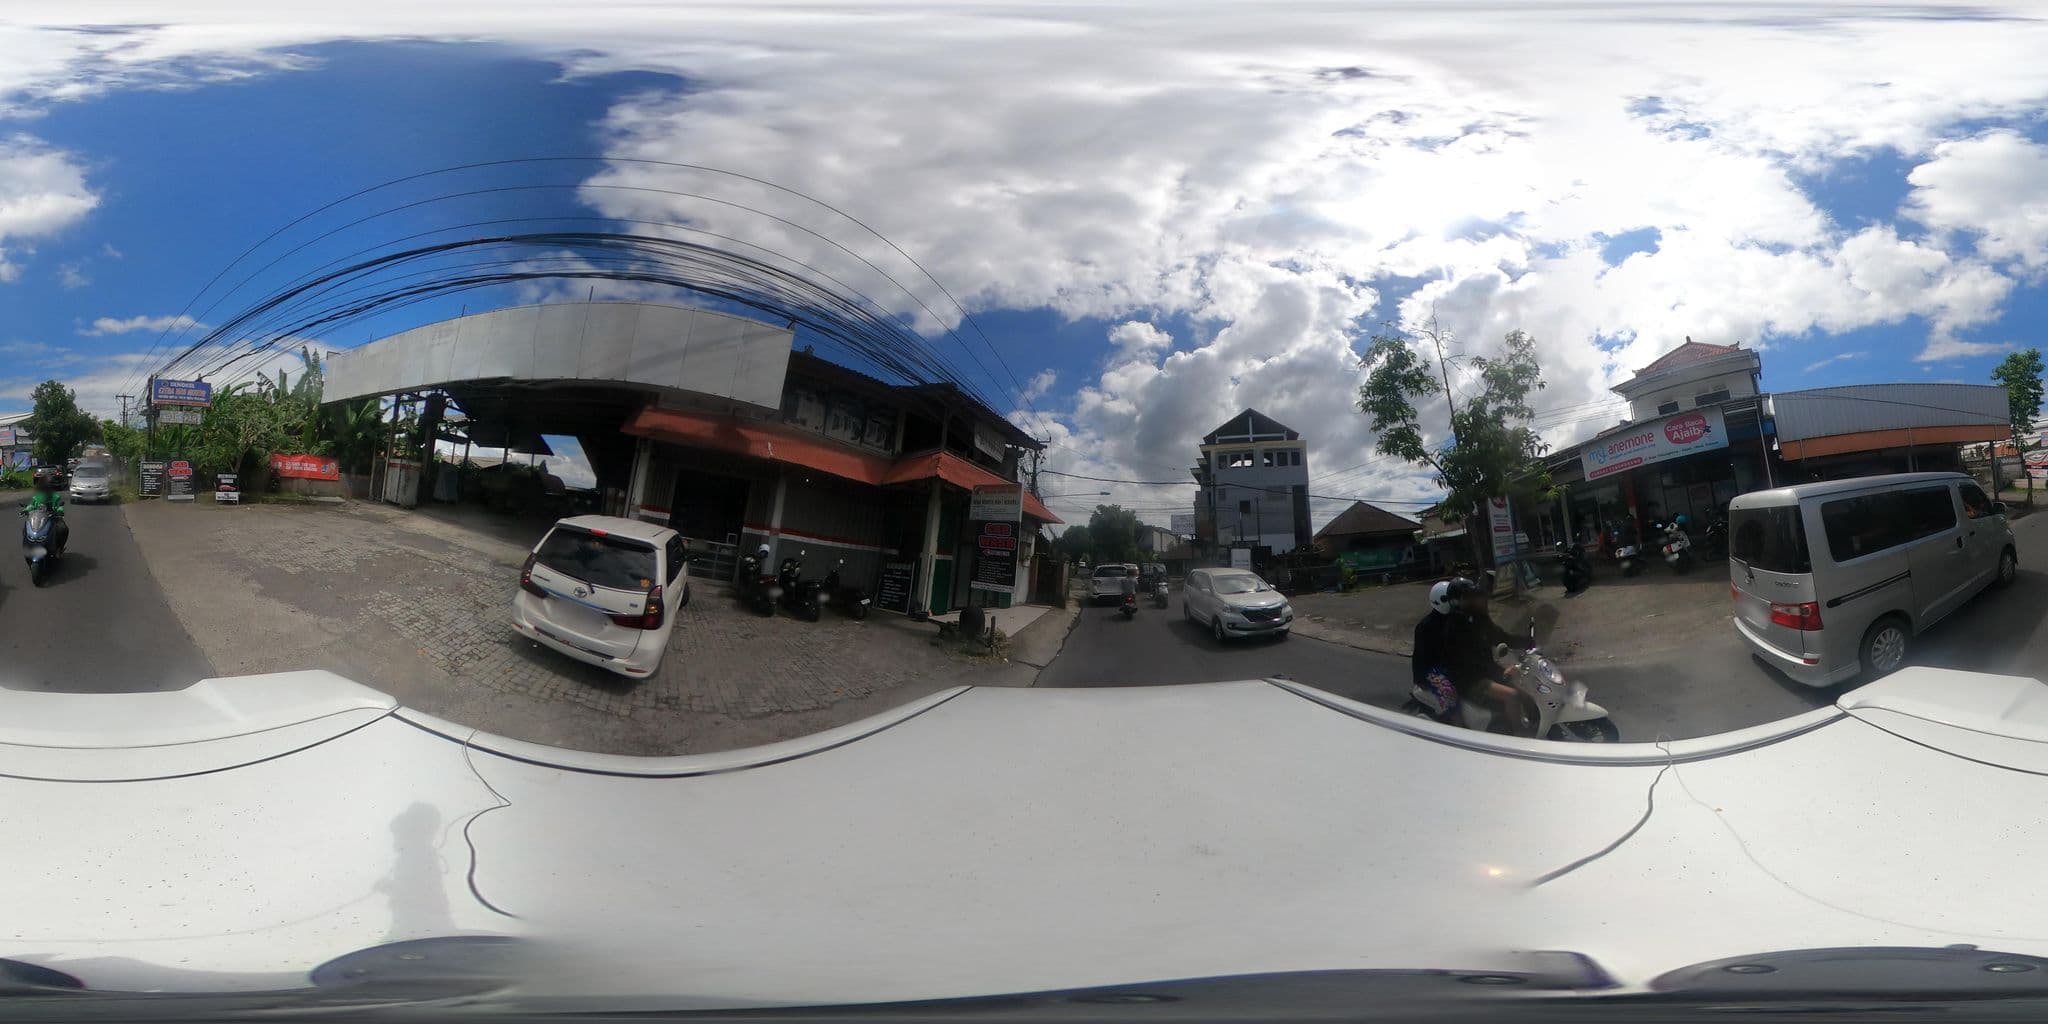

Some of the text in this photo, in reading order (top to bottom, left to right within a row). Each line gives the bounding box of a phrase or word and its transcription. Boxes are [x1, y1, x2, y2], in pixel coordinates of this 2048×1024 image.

[1672, 426, 1701, 441] Ajaib
[1589, 447, 1607, 464] my
[1608, 432, 1655, 455] anemone
